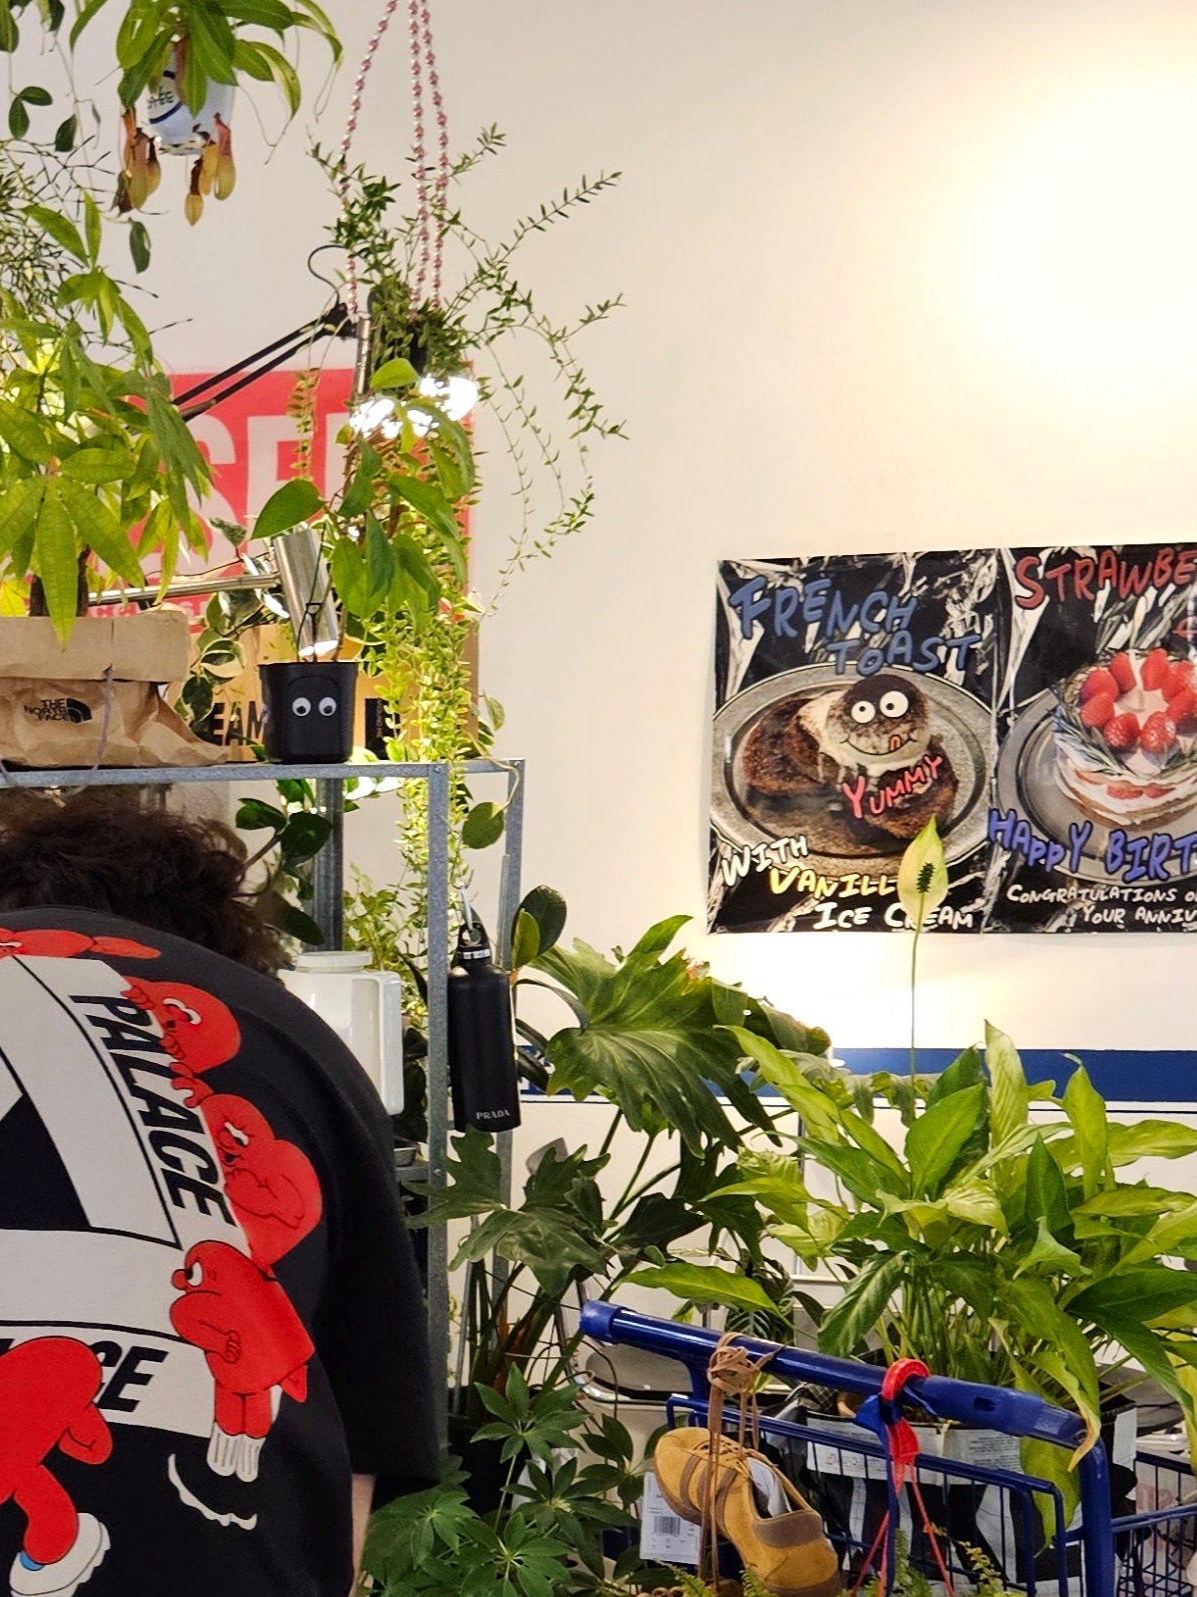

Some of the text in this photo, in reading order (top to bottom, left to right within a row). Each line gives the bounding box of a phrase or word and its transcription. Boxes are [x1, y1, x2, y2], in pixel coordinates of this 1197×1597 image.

[729, 576, 917, 639] FRENCH
[826, 631, 981, 676] TOAST
[40, 698, 65, 708] THE
[210, 701, 265, 746] EAM
[842, 754, 943, 819] YUMMY
[721, 834, 809, 888] WITH
[988, 807, 1093, 874] HAPPY
[769, 866, 899, 900] VANILL
[1006, 884, 1177, 905] CONGRATULATIONS
[813, 902, 871, 930] ICE
[1082, 905, 1126, 925] YOUR
[69, 994, 239, 1228] PALACE
[475, 1109, 511, 1121] PRADA
